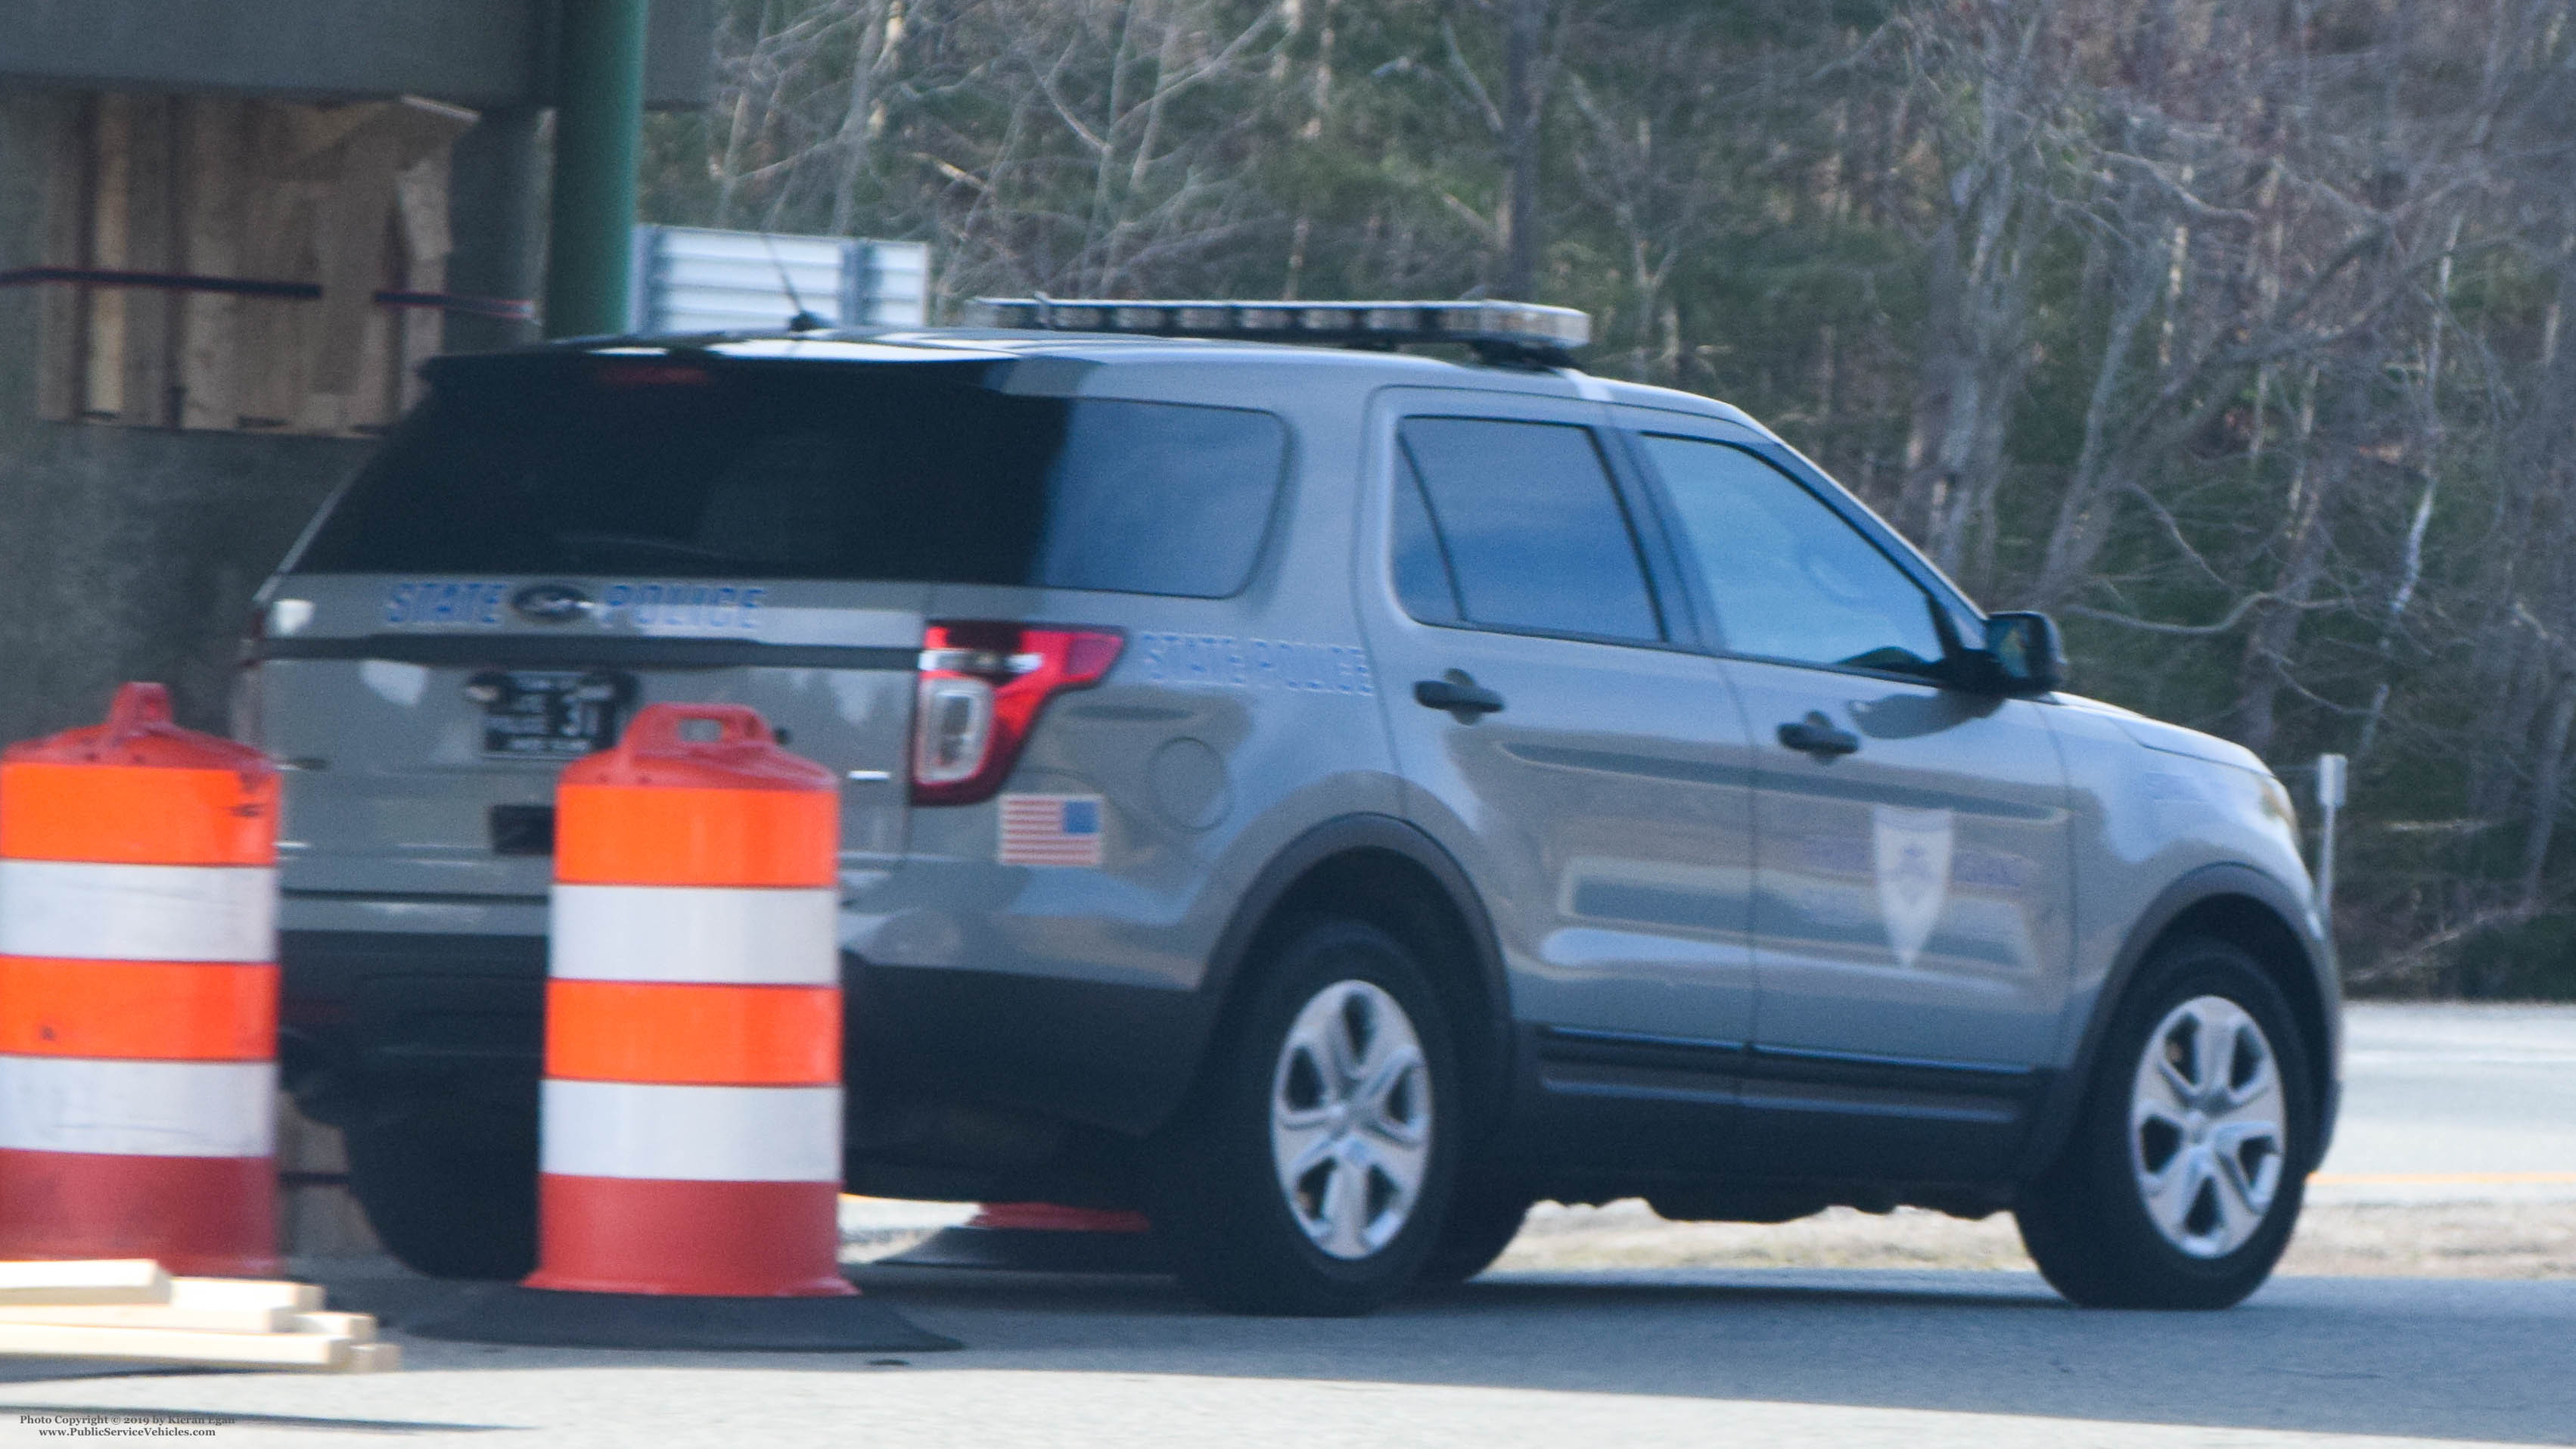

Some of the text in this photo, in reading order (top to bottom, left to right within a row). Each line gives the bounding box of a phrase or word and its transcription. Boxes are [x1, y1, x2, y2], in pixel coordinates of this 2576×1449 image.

[386, 581, 505, 624] STATE
[601, 583, 764, 630] POLICE
[1139, 631, 1374, 697] STATE POLICE
